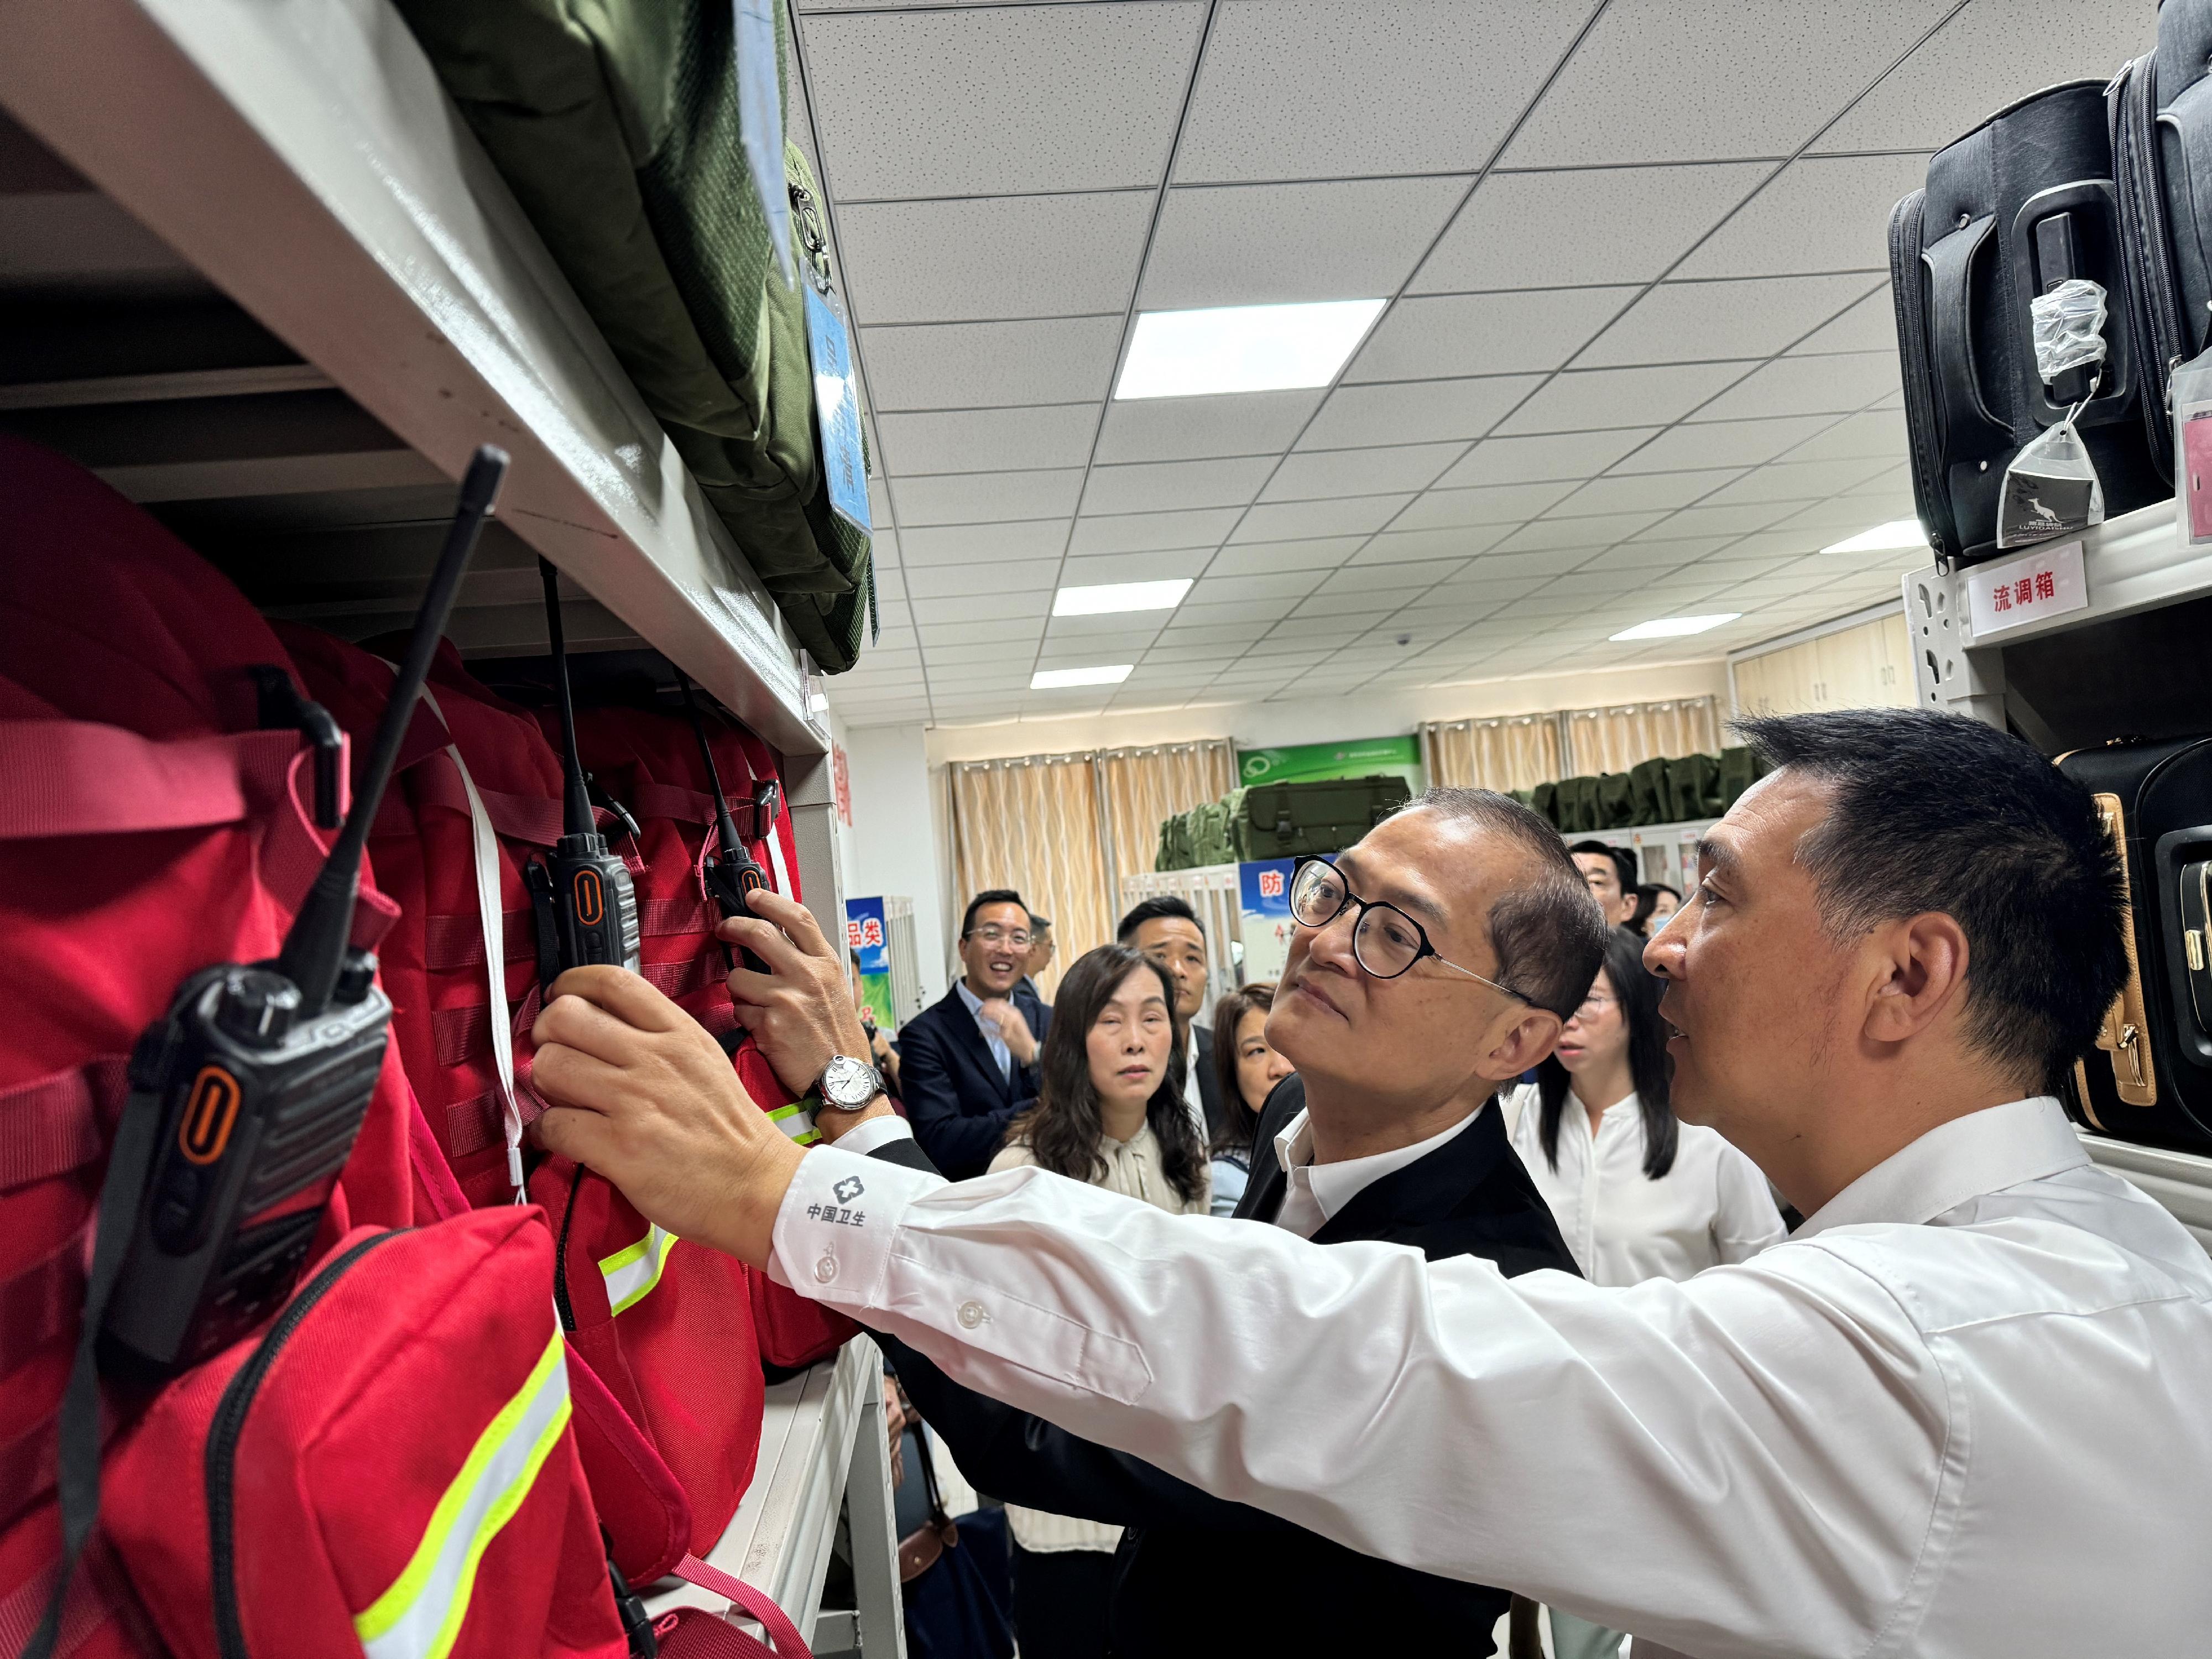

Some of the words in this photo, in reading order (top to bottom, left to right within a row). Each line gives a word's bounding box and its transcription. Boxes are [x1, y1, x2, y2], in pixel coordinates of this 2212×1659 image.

[1993, 571, 2054, 612] 流调箱
[807, 1203, 866, 1227] 中国卫生
